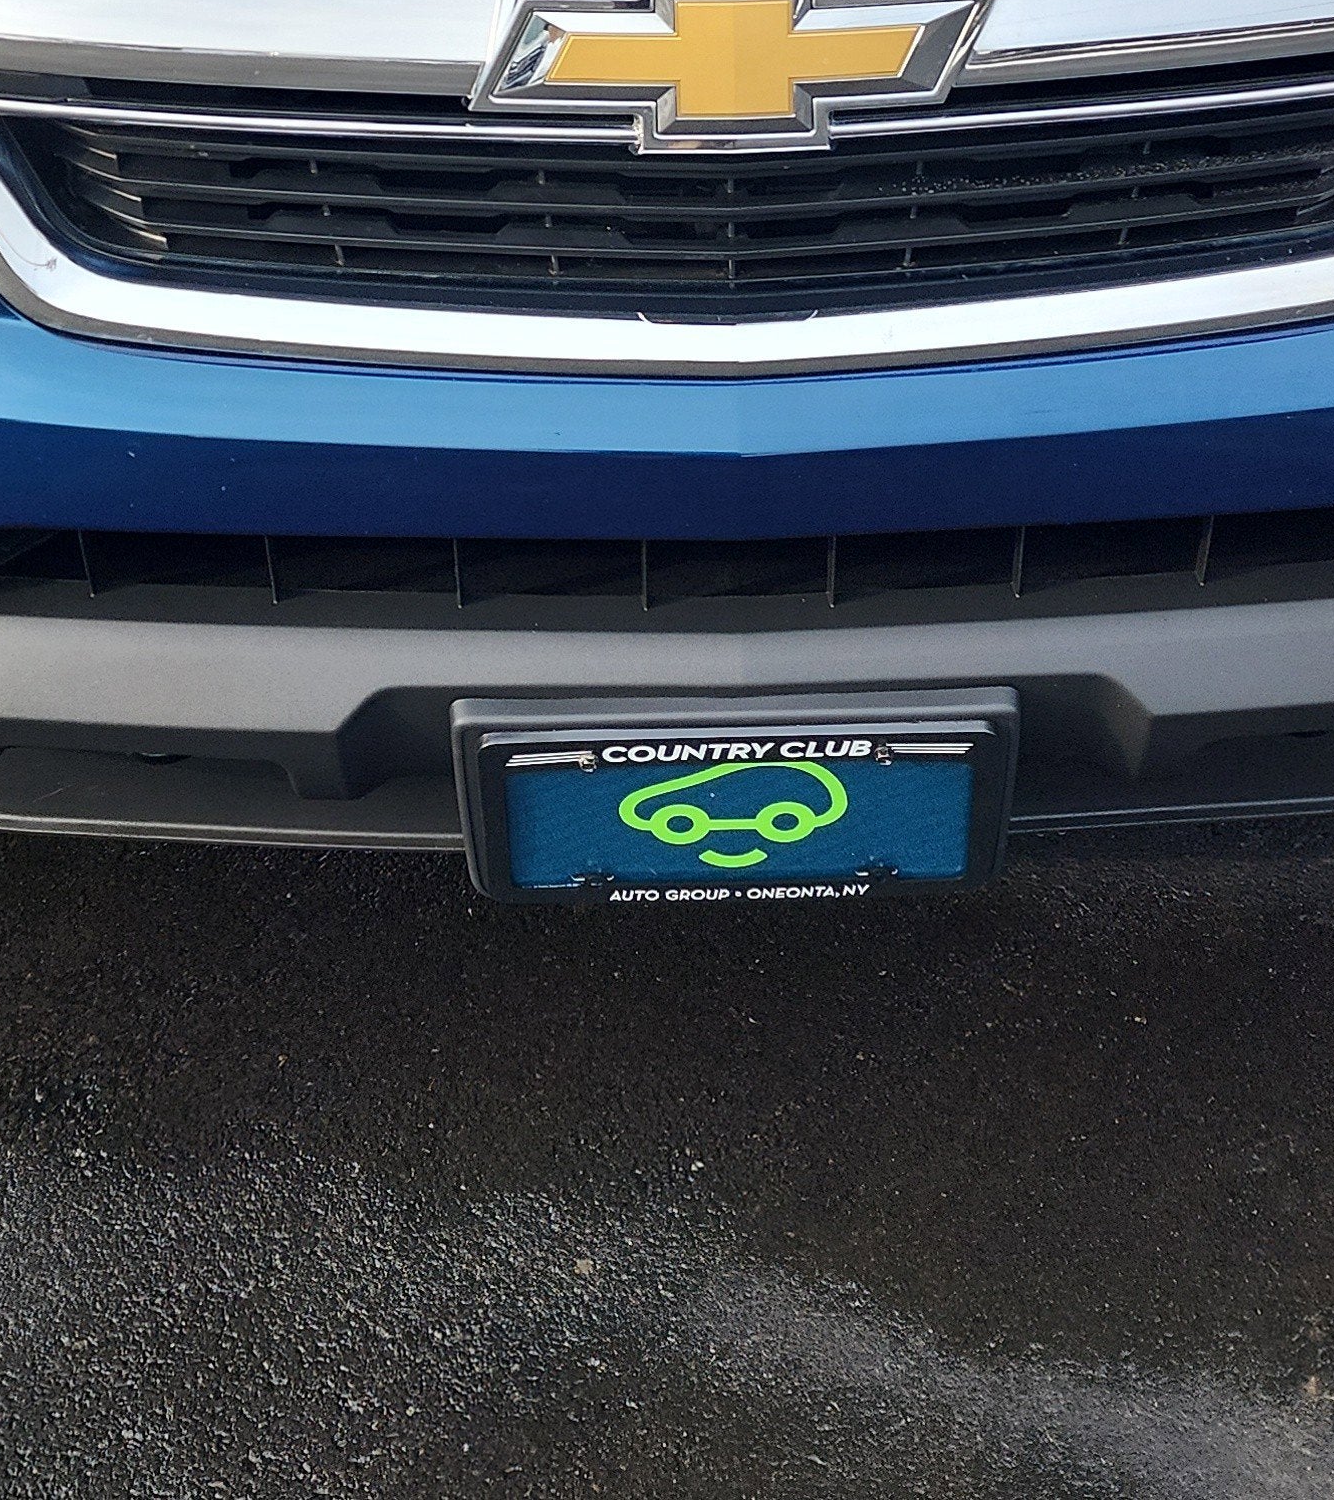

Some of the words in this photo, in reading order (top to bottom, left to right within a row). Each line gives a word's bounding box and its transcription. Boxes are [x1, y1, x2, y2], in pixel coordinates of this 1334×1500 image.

[601, 742, 776, 763] COUNTRY
[779, 740, 873, 759] CLUB
[609, 889, 660, 901] AUTO
[665, 888, 731, 901] GROUP
[746, 885, 841, 900] ONEONTA,
[842, 884, 870, 896] NY
